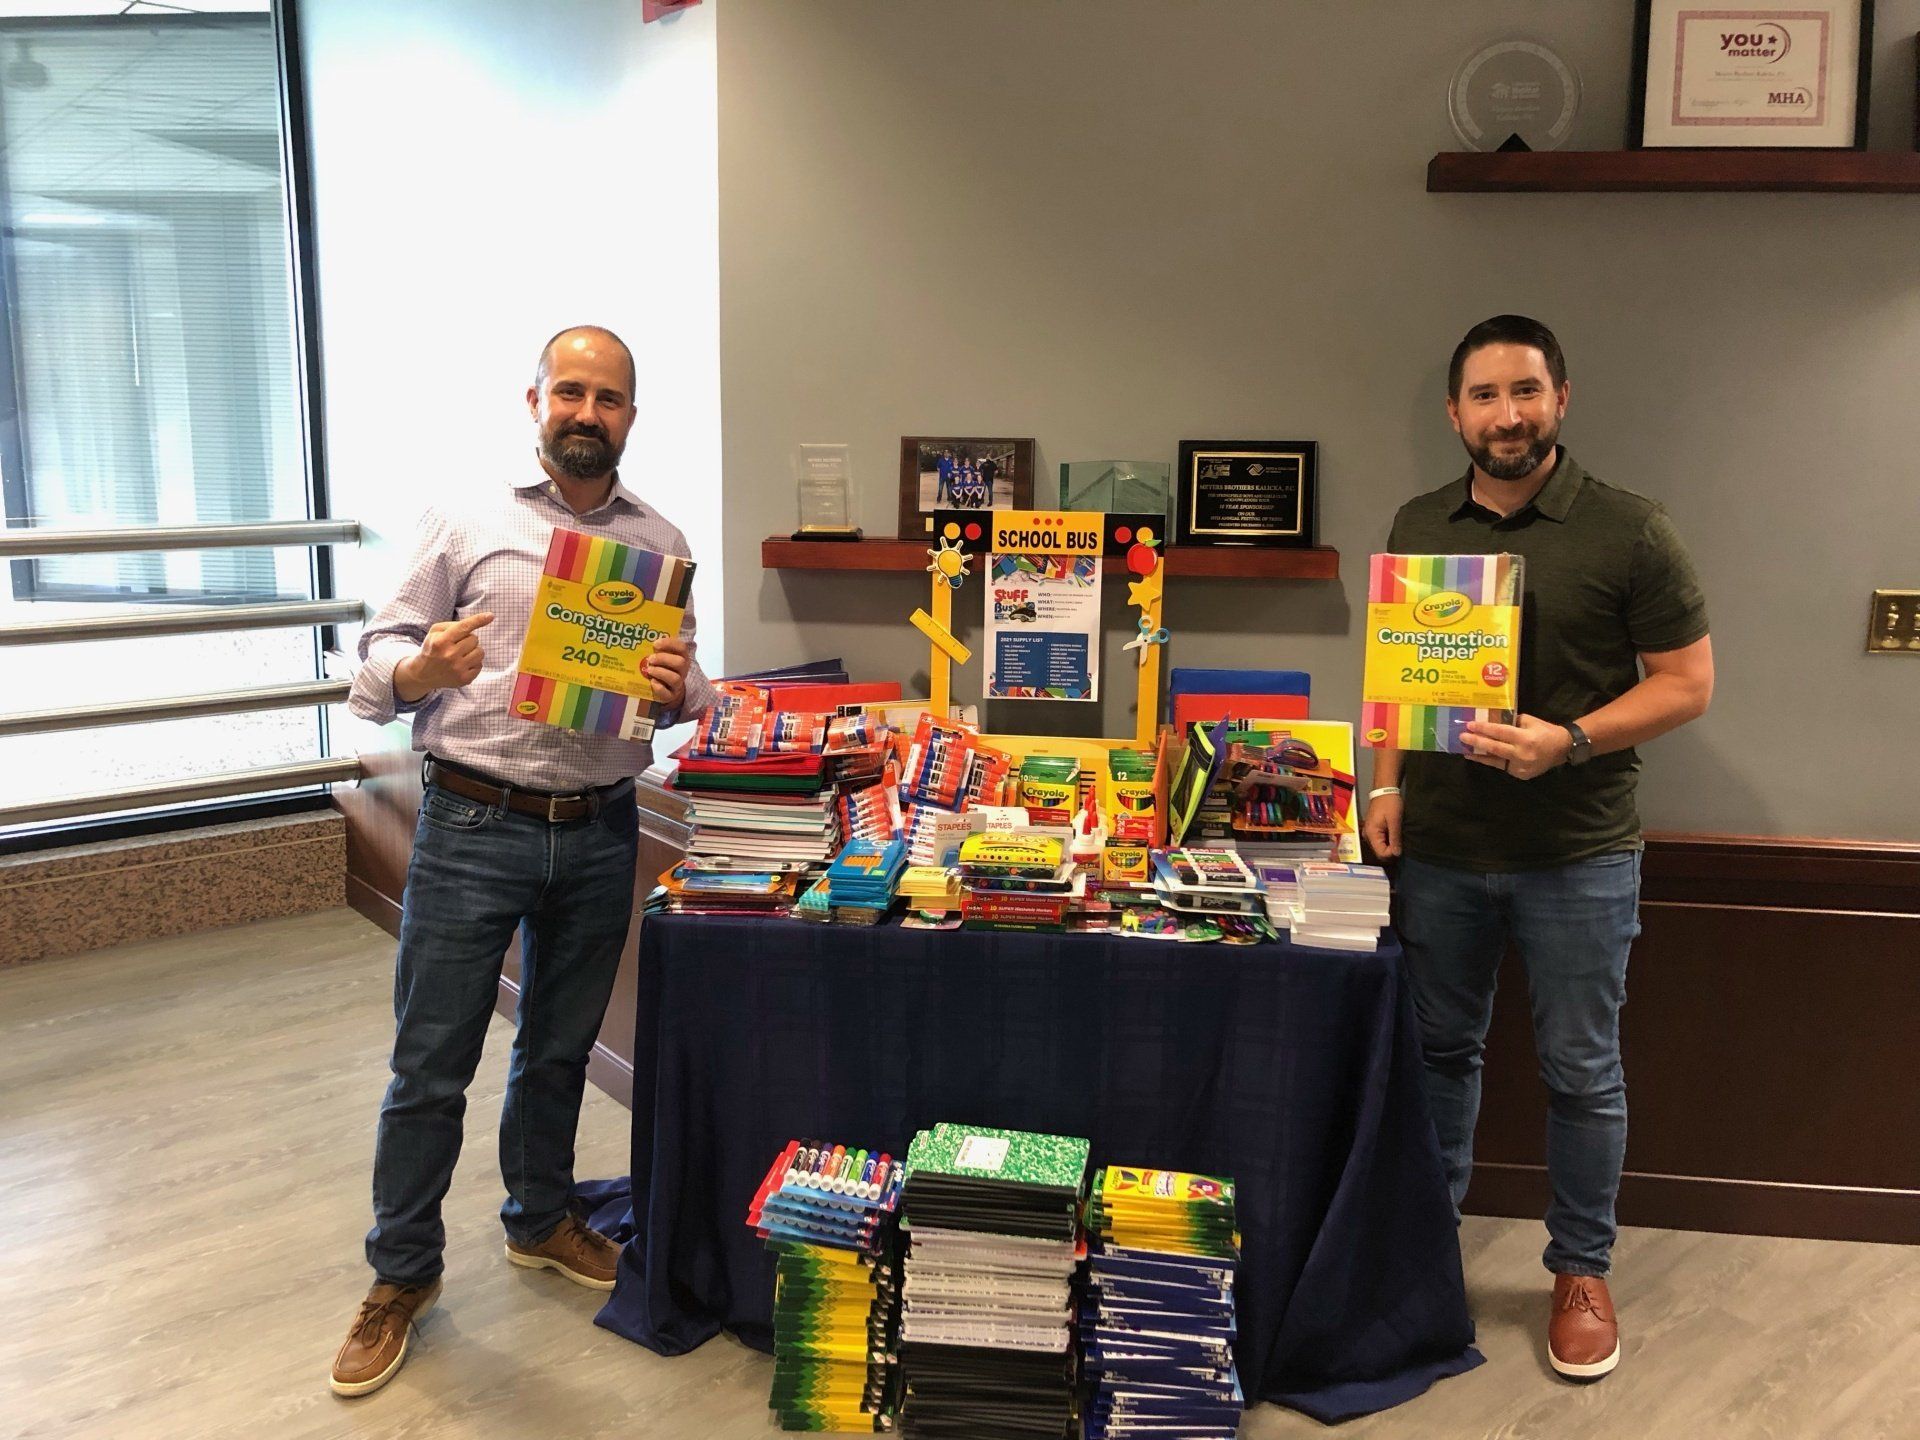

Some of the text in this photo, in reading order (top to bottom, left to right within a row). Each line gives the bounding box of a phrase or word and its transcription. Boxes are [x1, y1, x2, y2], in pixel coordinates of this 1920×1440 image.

[1720, 34, 1763, 50] you
[1728, 48, 1776, 57] matter
[1768, 92, 1805, 104] MHA
[998, 530, 1098, 550] SCHOOL BUS
[598, 588, 635, 598] Crayola
[1423, 598, 1462, 613] Crayola
[546, 602, 670, 642] Construction
[582, 626, 642, 650] paper
[1377, 628, 1508, 648] Construction
[561, 646, 600, 667] 240
[1417, 645, 1478, 663] paper
[1401, 667, 1439, 684] 240
[1487, 664, 1503, 675] 12
[1020, 774, 1029, 782] 10
[1117, 771, 1128, 781] 12
[1026, 787, 1065, 798] Crayola
[937, 822, 972, 831] STAPLES
